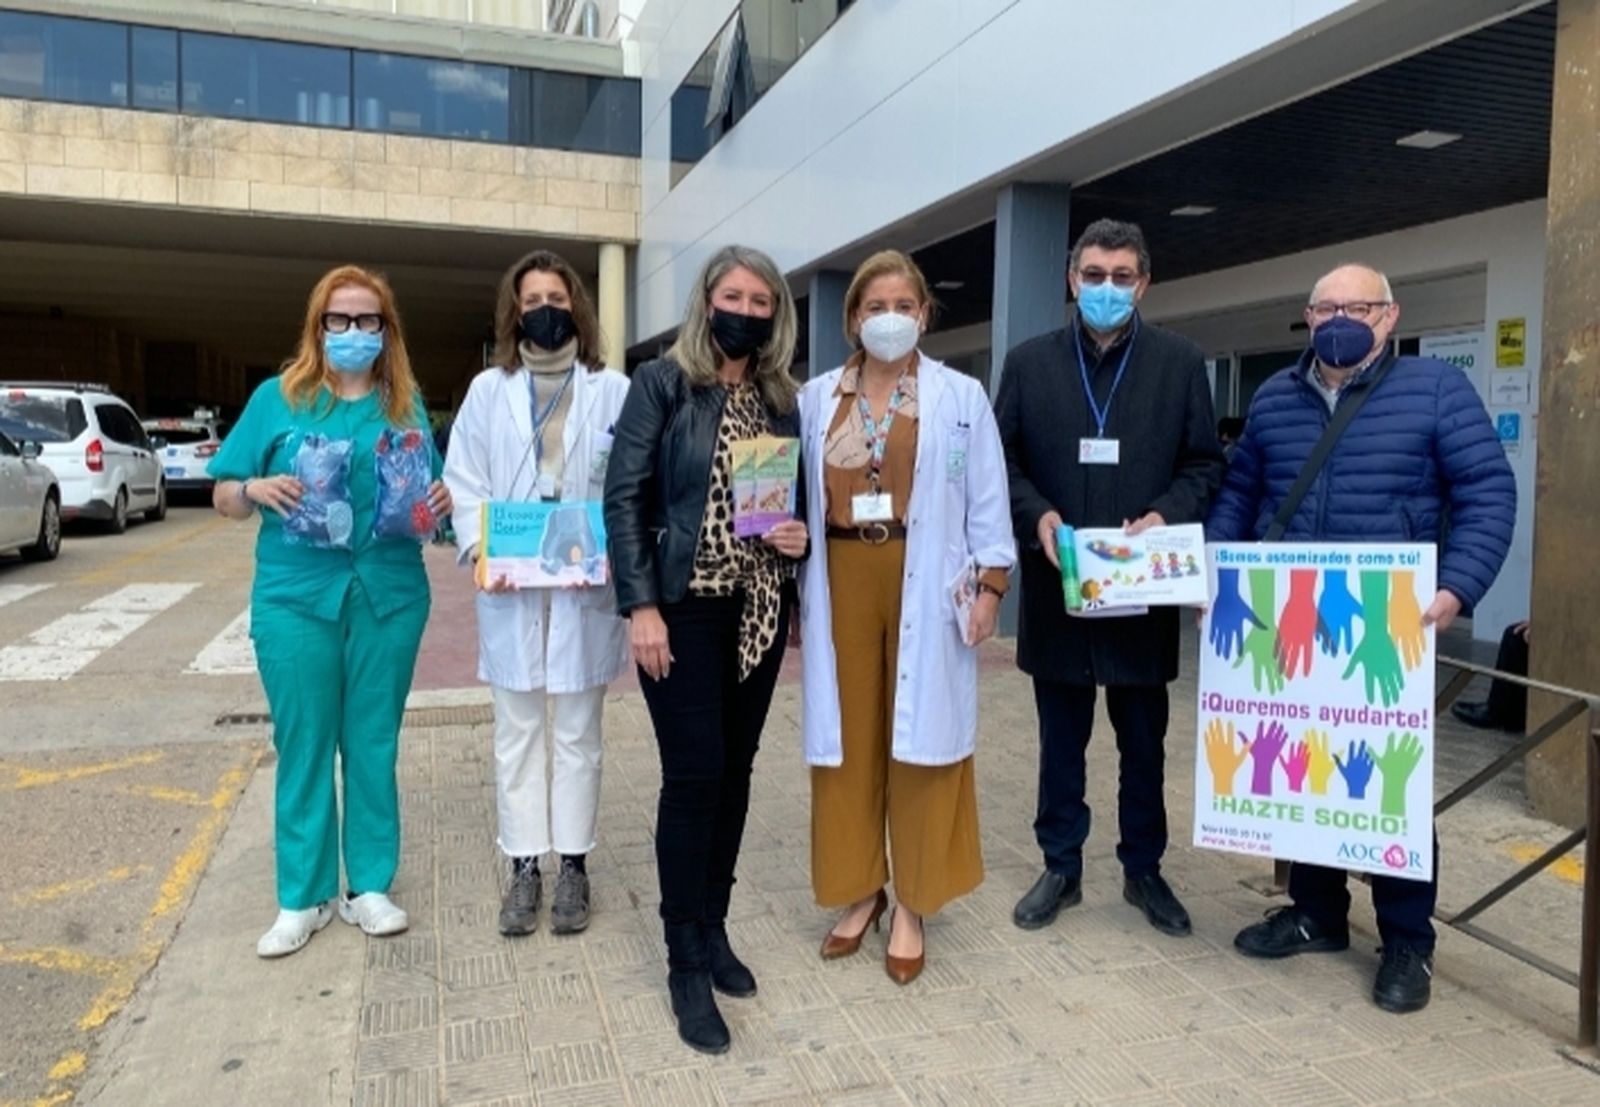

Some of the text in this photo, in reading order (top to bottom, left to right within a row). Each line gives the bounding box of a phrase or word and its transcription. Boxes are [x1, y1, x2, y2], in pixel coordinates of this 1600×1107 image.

[1356, 553, 1395, 565] como
[1400, 551, 1421, 566] tú!
[1201, 692, 1429, 730] ¡Queremos ayudarte!
[1213, 796, 1409, 836] ¡HAZTE SOCIO!
